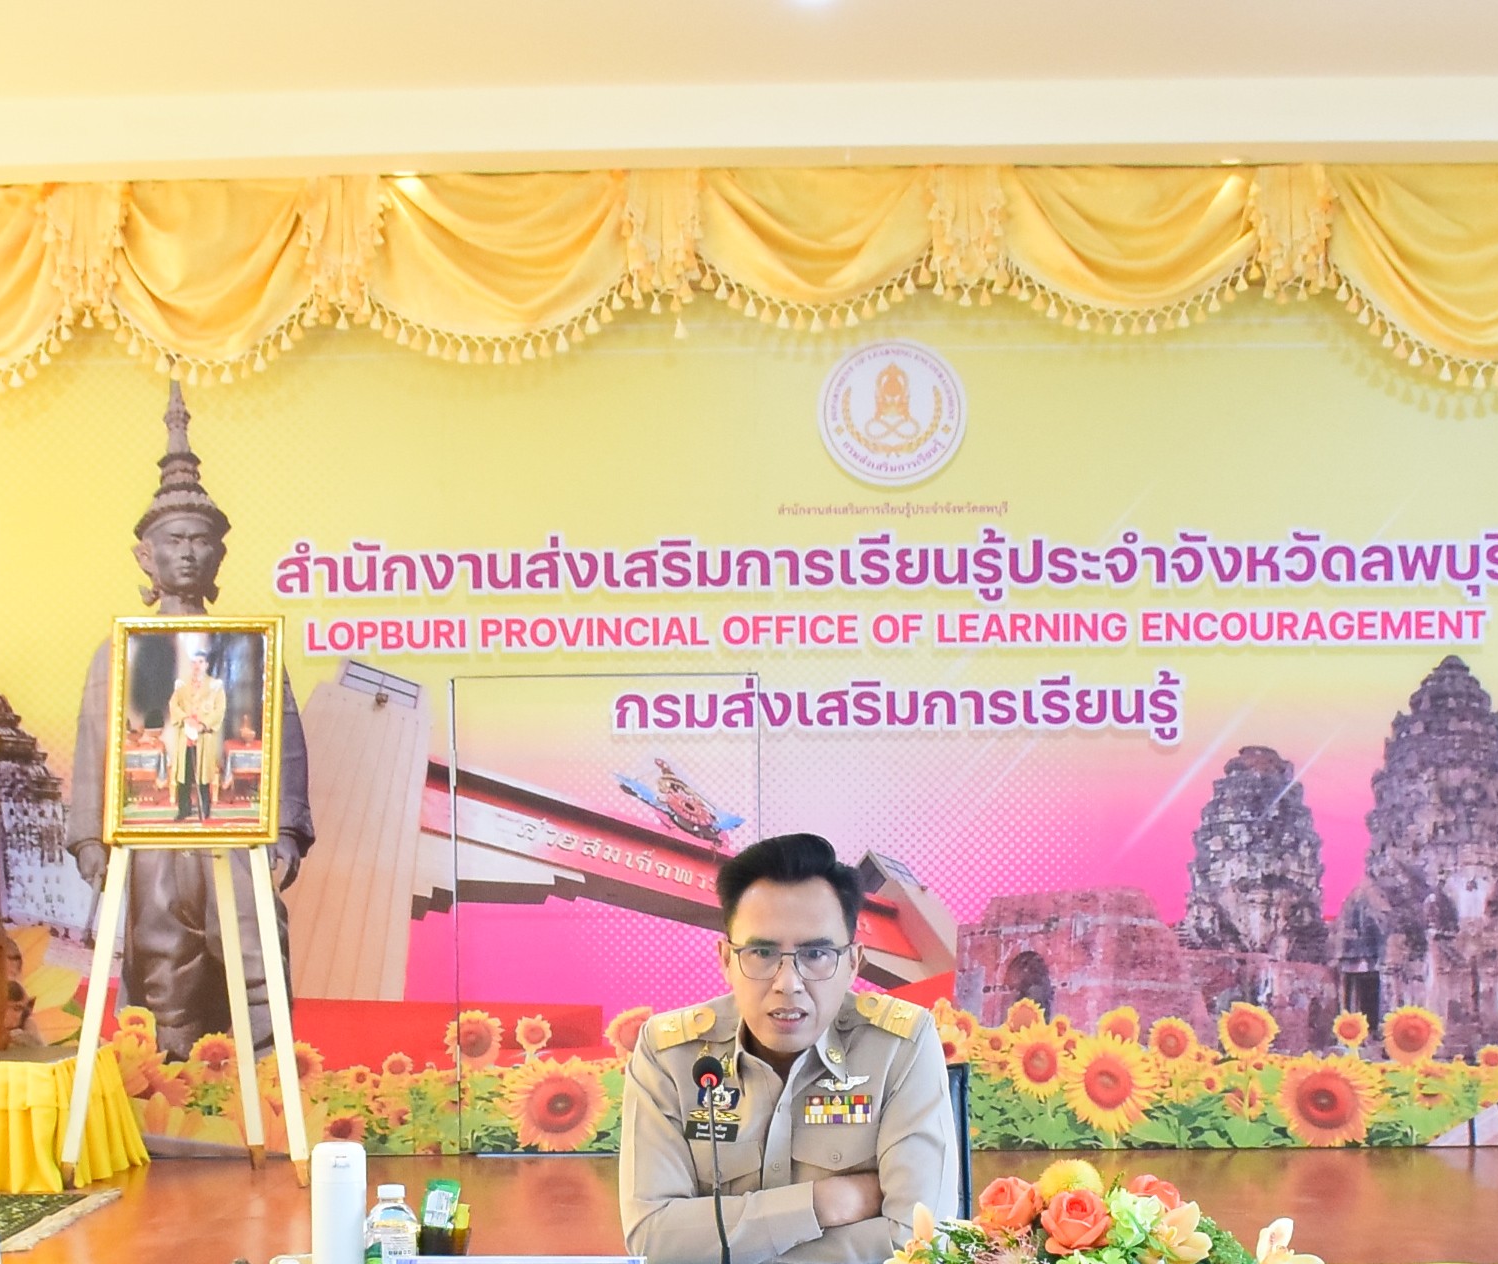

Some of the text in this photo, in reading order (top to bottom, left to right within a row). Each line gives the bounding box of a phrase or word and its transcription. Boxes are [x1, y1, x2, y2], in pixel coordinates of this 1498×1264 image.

[307, 609, 1486, 651] LOPBURI PROVINCIAL OFFICE OF LEARNING ENCOURAGEMENT
[615, 671, 1181, 740] กรมส่งเสริมการเรียนรู้
